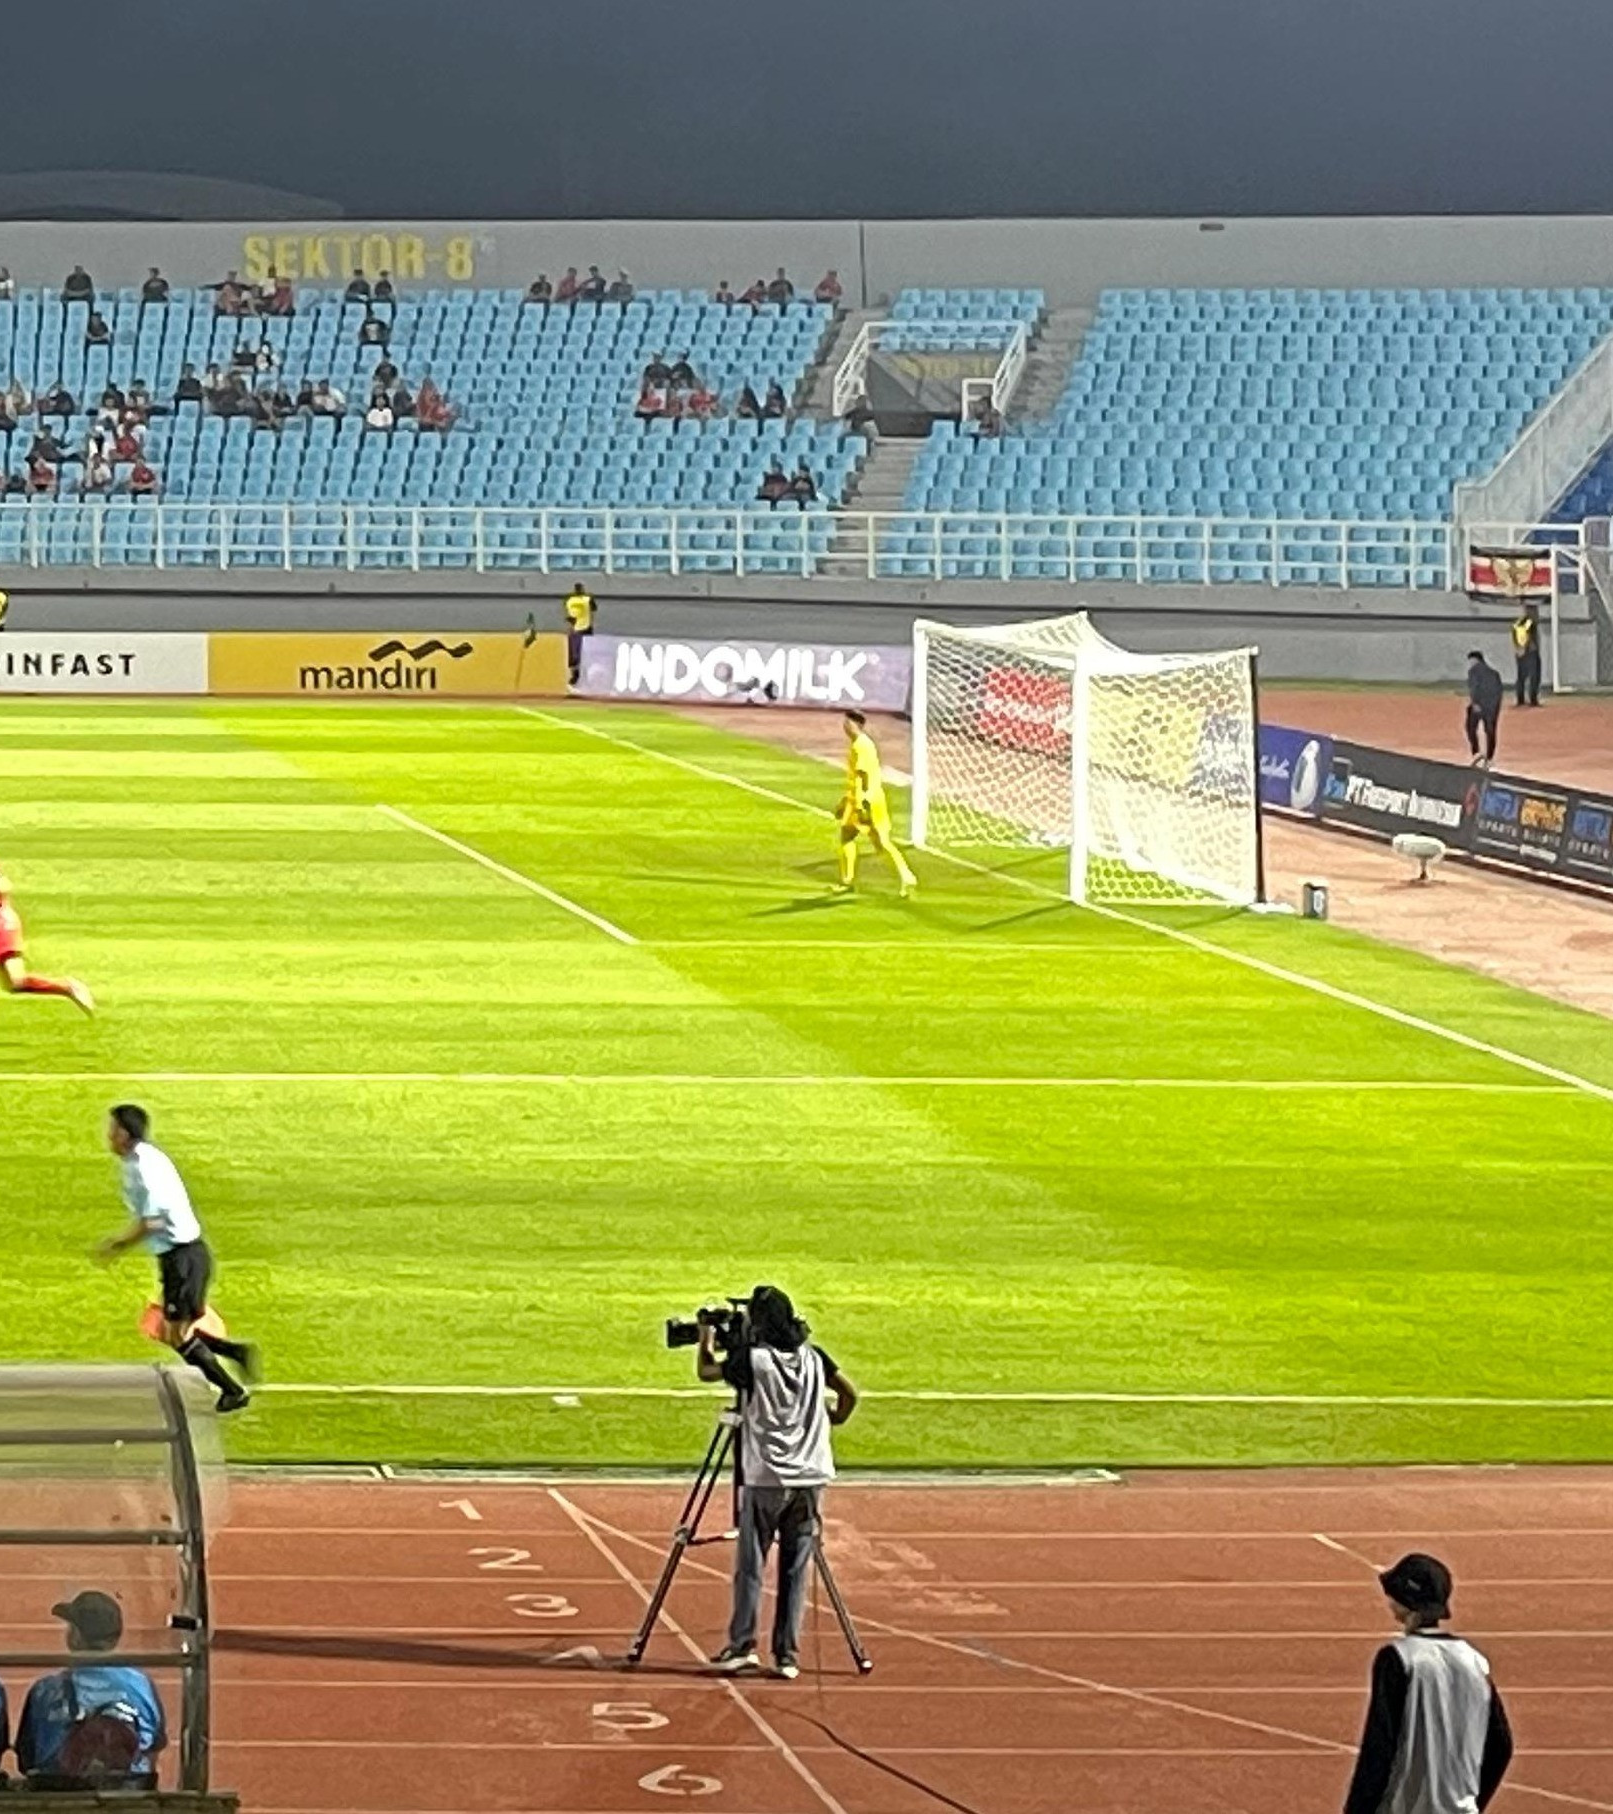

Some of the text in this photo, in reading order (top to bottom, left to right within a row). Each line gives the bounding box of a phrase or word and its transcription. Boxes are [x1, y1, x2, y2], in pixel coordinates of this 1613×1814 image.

[299, 659, 436, 690] mandiri
[615, 641, 868, 701] INDOMILK
[439, 1499, 483, 1521] 1
[466, 1546, 544, 1571] 2
[505, 1593, 580, 1617] 3
[592, 1702, 670, 1731] 5
[638, 1764, 724, 1796] 6
